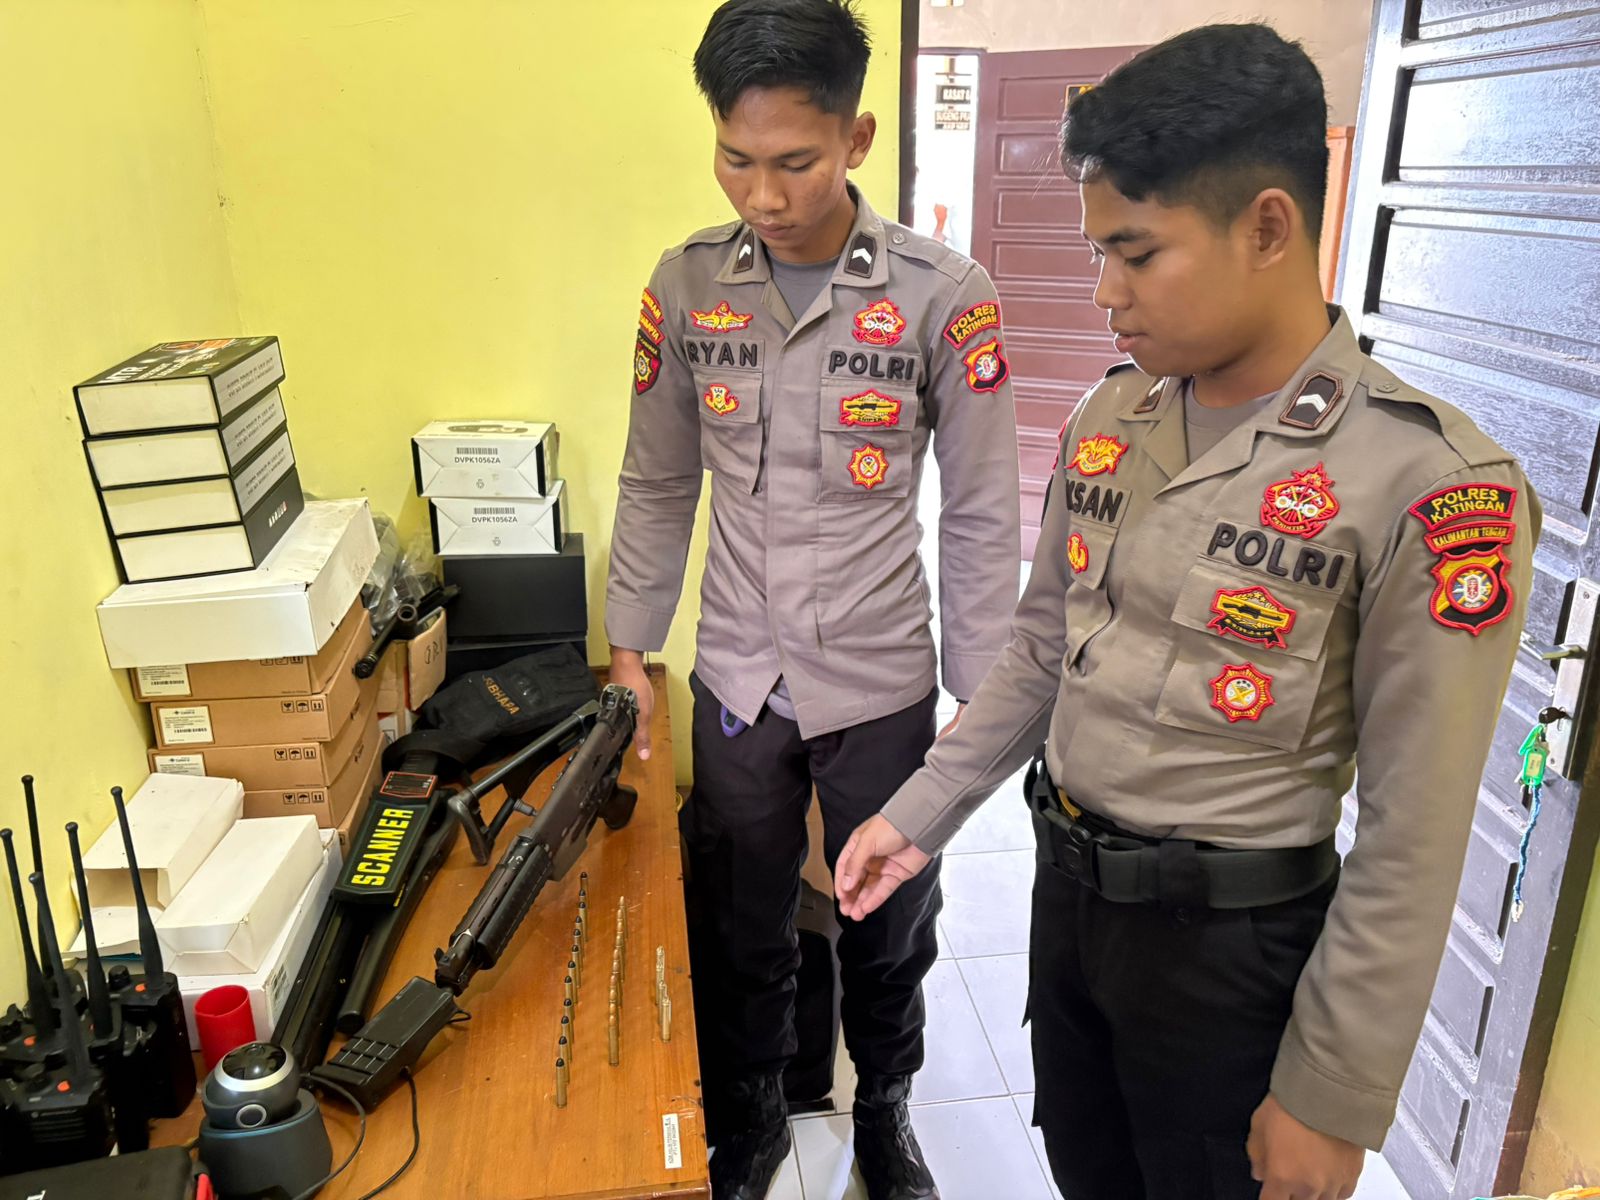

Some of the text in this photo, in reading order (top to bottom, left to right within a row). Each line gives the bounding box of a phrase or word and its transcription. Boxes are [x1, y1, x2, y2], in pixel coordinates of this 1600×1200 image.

[950, 304, 996, 336] POLRES
[956, 315, 997, 342] KATINGAN
[686, 341, 758, 368] RYAN
[828, 350, 916, 381] POLRI
[454, 456, 501, 464] DVPK1056ZA
[1430, 499, 1505, 524] KATINGAN
[1431, 487, 1499, 512] POLRES
[1431, 528, 1480, 547] KALIMANTAN
[1206, 522, 1345, 589] POLRI
[351, 808, 415, 887] SCANNER
